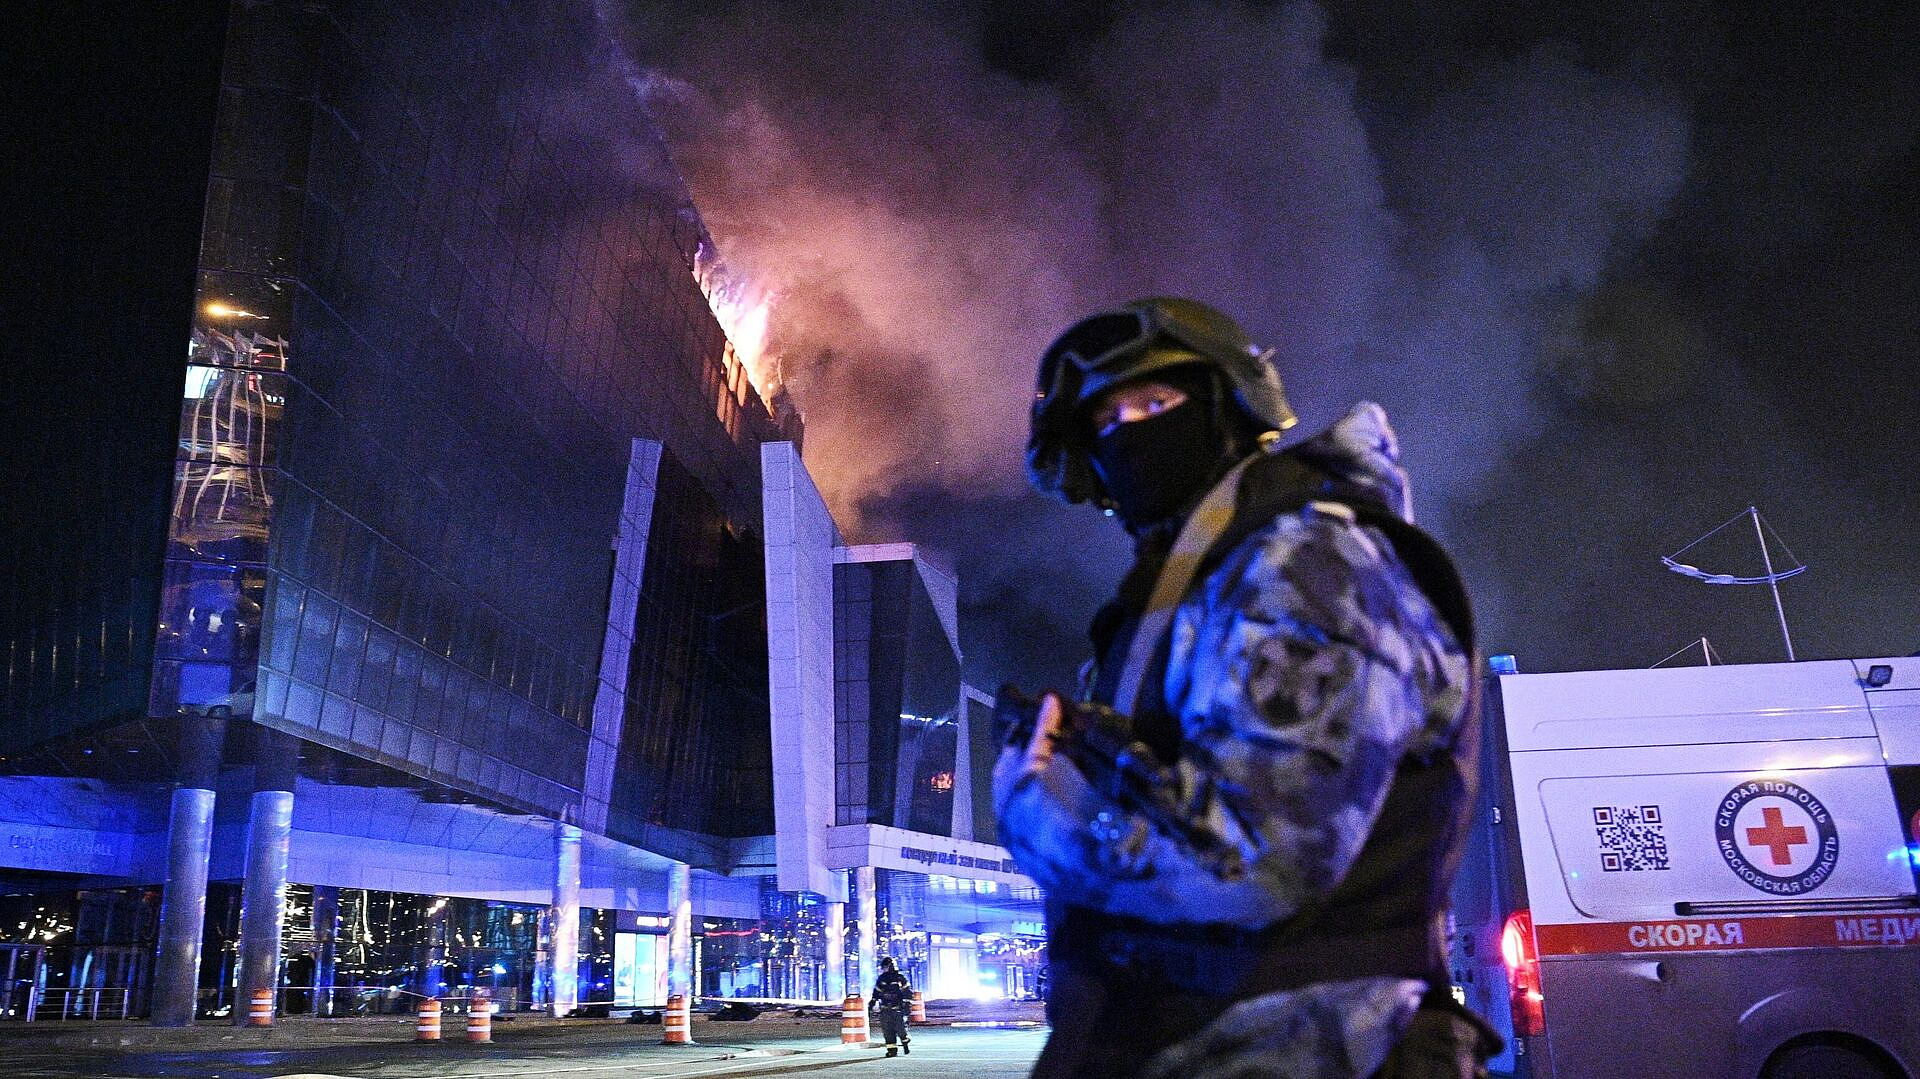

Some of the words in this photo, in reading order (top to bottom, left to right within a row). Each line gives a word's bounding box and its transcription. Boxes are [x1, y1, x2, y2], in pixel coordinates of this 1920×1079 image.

[1719, 783, 1759, 827] СКОРАЯ
[1764, 782, 1826, 824] ПОМОЩЬ
[1720, 839, 1800, 893] МОСКОВСКАЯ
[1802, 836, 1836, 888] ОБЛАСТЬ
[1628, 922, 1744, 948] СКОРАЯ
